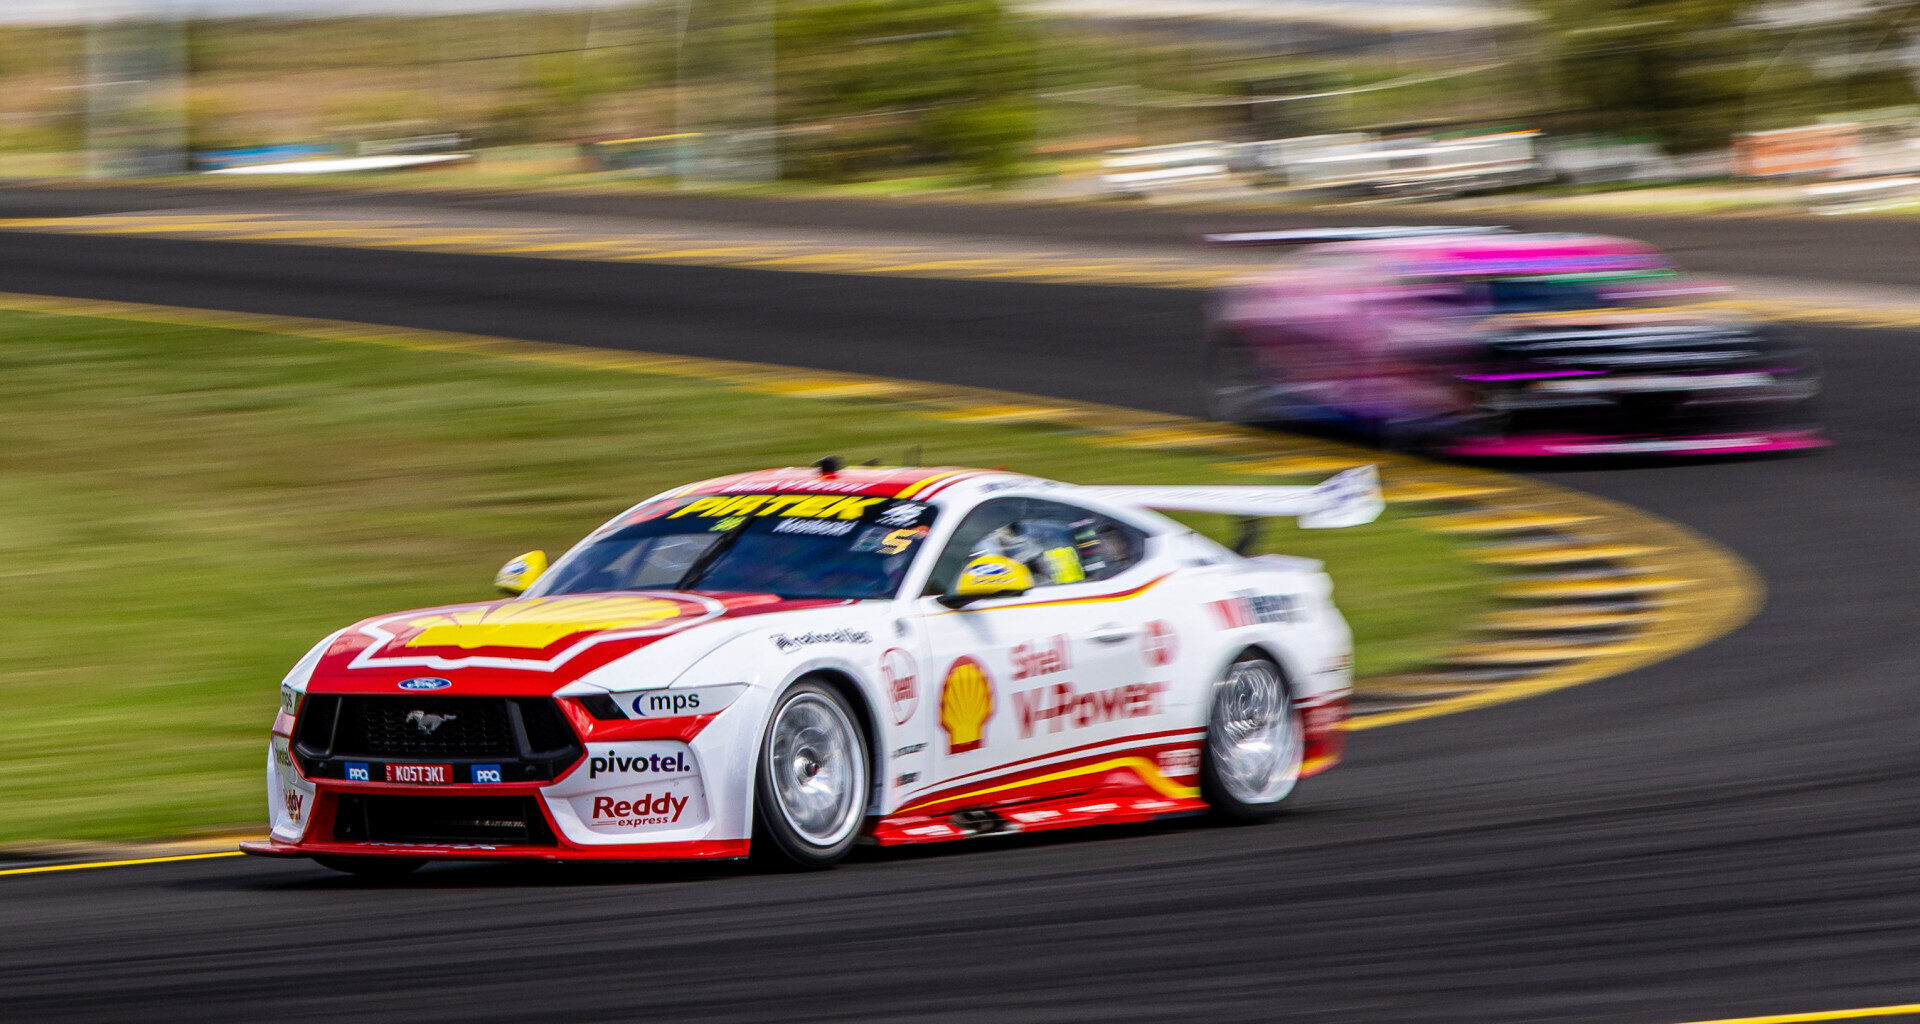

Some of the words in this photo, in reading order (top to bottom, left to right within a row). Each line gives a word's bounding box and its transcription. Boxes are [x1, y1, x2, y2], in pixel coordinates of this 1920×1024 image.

[666, 494, 890, 520] PIRTEK
[650, 693, 700, 714] mps
[349, 767, 370, 782] PPQ
[476, 769, 502, 783] PPQ
[592, 792, 689, 823] Reddy
[617, 816, 669, 828] express
